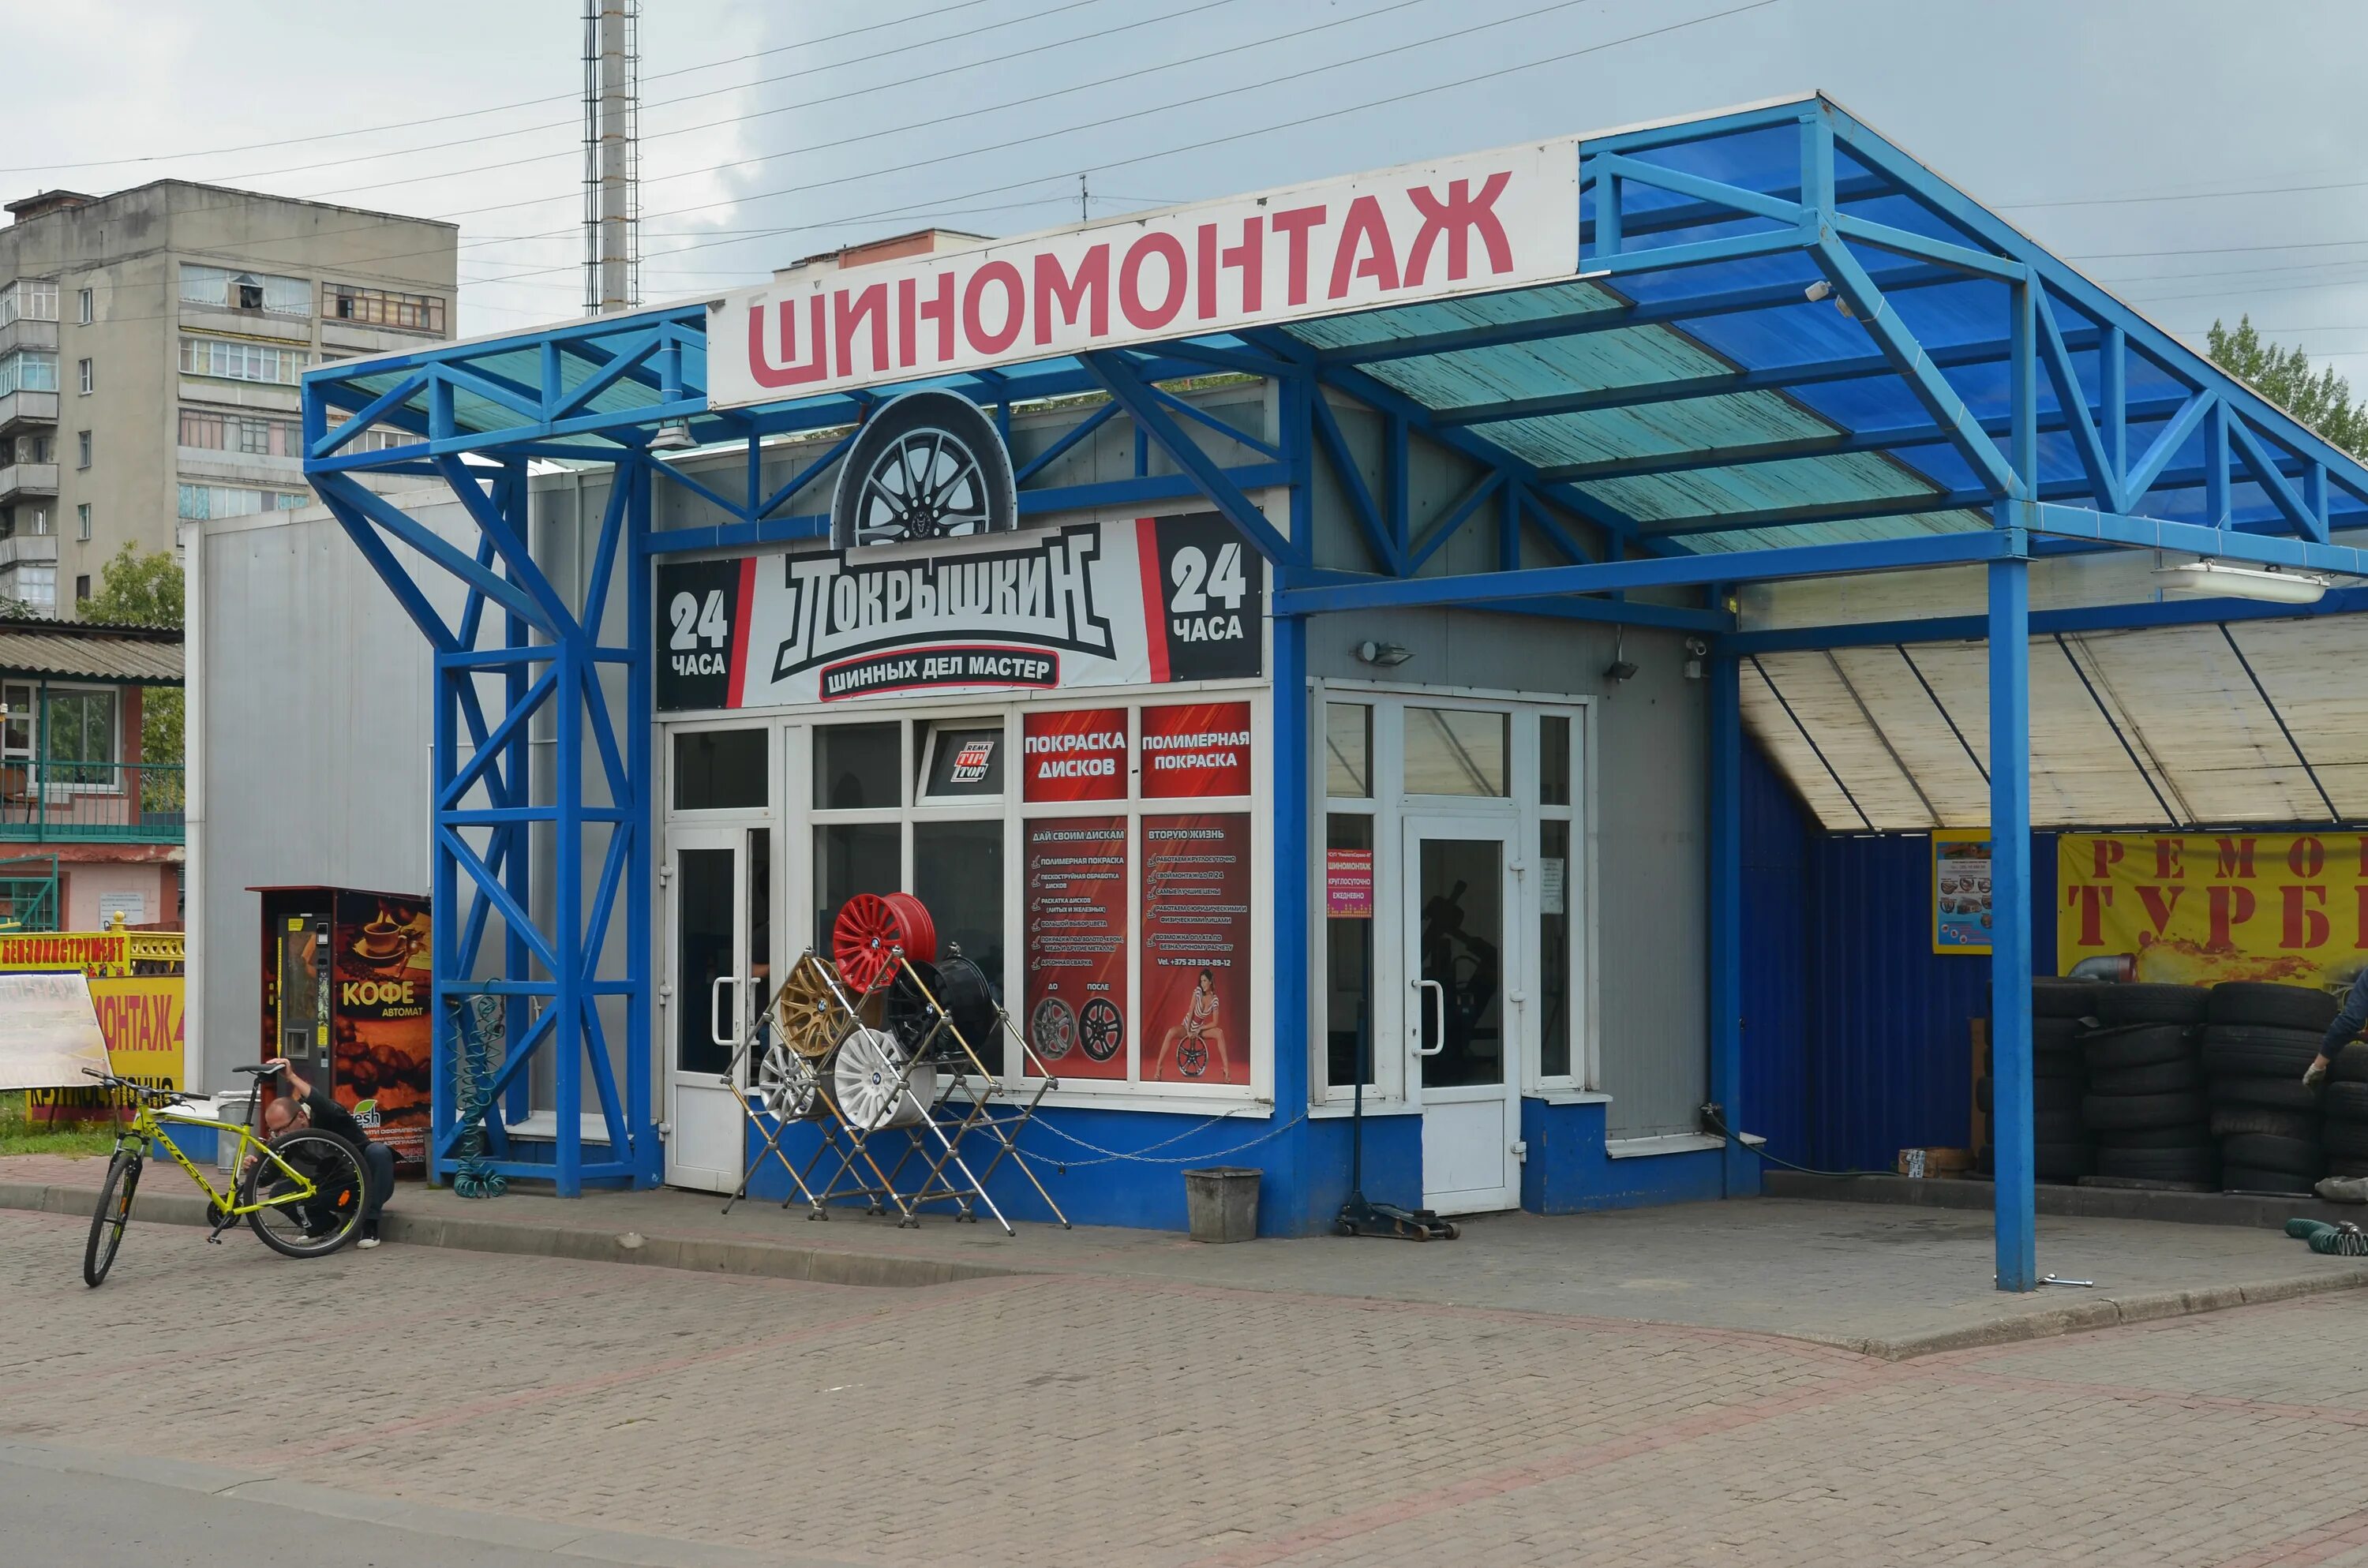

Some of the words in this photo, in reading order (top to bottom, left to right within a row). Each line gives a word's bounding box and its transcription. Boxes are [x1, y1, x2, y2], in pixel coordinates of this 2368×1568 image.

[748, 170, 1514, 389] ШИНОМОНТАЖ
[1171, 542, 1246, 613] 24
[778, 533, 1107, 671] ПОКРЫШКИН
[670, 589, 728, 650] 24
[1173, 615, 1244, 642] ЧАСА
[672, 653, 726, 676] ЧАСА
[828, 659, 918, 694] ШИННЫХ
[922, 657, 963, 679] ДЕЛ
[969, 657, 1050, 679] МАСТЕР
[1025, 732, 1126, 754] ПОКРАСКА
[1142, 731, 1250, 750] ПОЛИМЕРНАЯ
[959, 753, 984, 765] TIP
[1038, 758, 1115, 778] ДИСКОВ
[1155, 753, 1237, 769] ПОКРАСКА
[959, 766, 985, 777] TOP
[1032, 830, 1051, 841] ДАЙ
[1053, 831, 1085, 840] СВОИМ
[1086, 830, 1125, 840] ДИСКАМ
[1148, 830, 1188, 840] ВТОРУЮ
[1189, 830, 1224, 839] ЖИЗНЬ
[343, 981, 414, 1006] КОФЕ
[382, 1007, 423, 1017] АВТОМАТ
